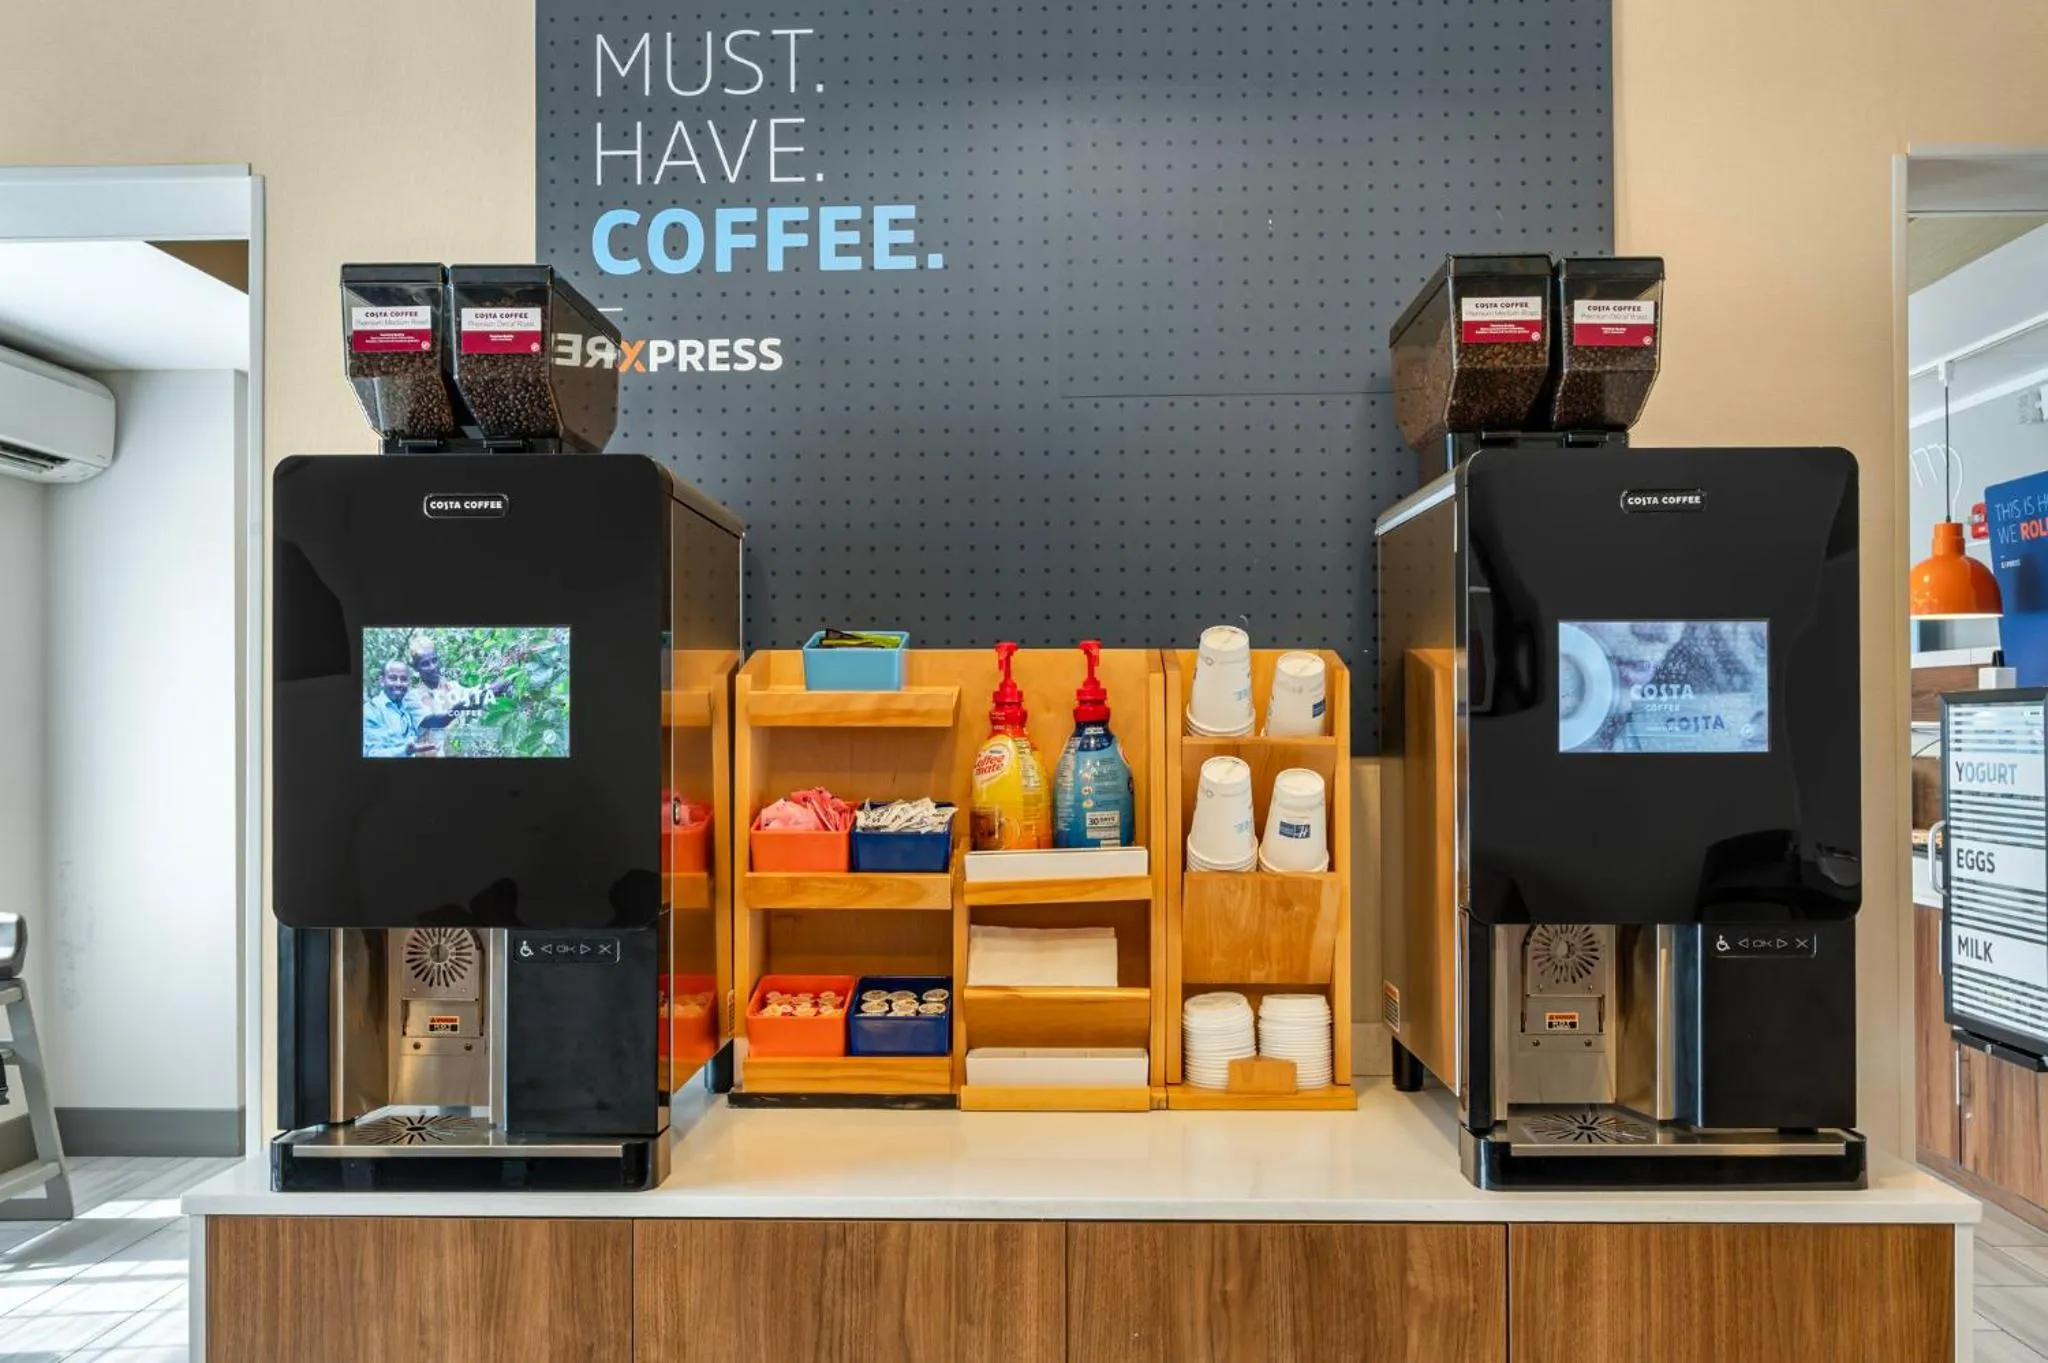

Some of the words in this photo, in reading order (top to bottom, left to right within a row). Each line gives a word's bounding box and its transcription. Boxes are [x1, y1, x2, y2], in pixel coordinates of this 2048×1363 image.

[596, 29, 824, 97] MUST.
[596, 118, 824, 186] HAVE.
[592, 205, 943, 275] COFFEE.
[618, 338, 783, 373] XPRESS
[429, 500, 461, 510] COSTA
[463, 500, 503, 509] COFFEE
[1627, 496, 1659, 506] COSTA
[1661, 495, 1701, 504] COFFEE
[1994, 499, 2021, 522] THIS
[2024, 495, 2035, 516] IS
[1996, 523, 2018, 545] WE
[1630, 684, 1696, 703] COSTA
[1644, 703, 1680, 713] COFFEE
[1955, 761, 2018, 785] YOGURT
[1956, 848, 1996, 874] EGGS
[1957, 934, 1993, 963] MILK
